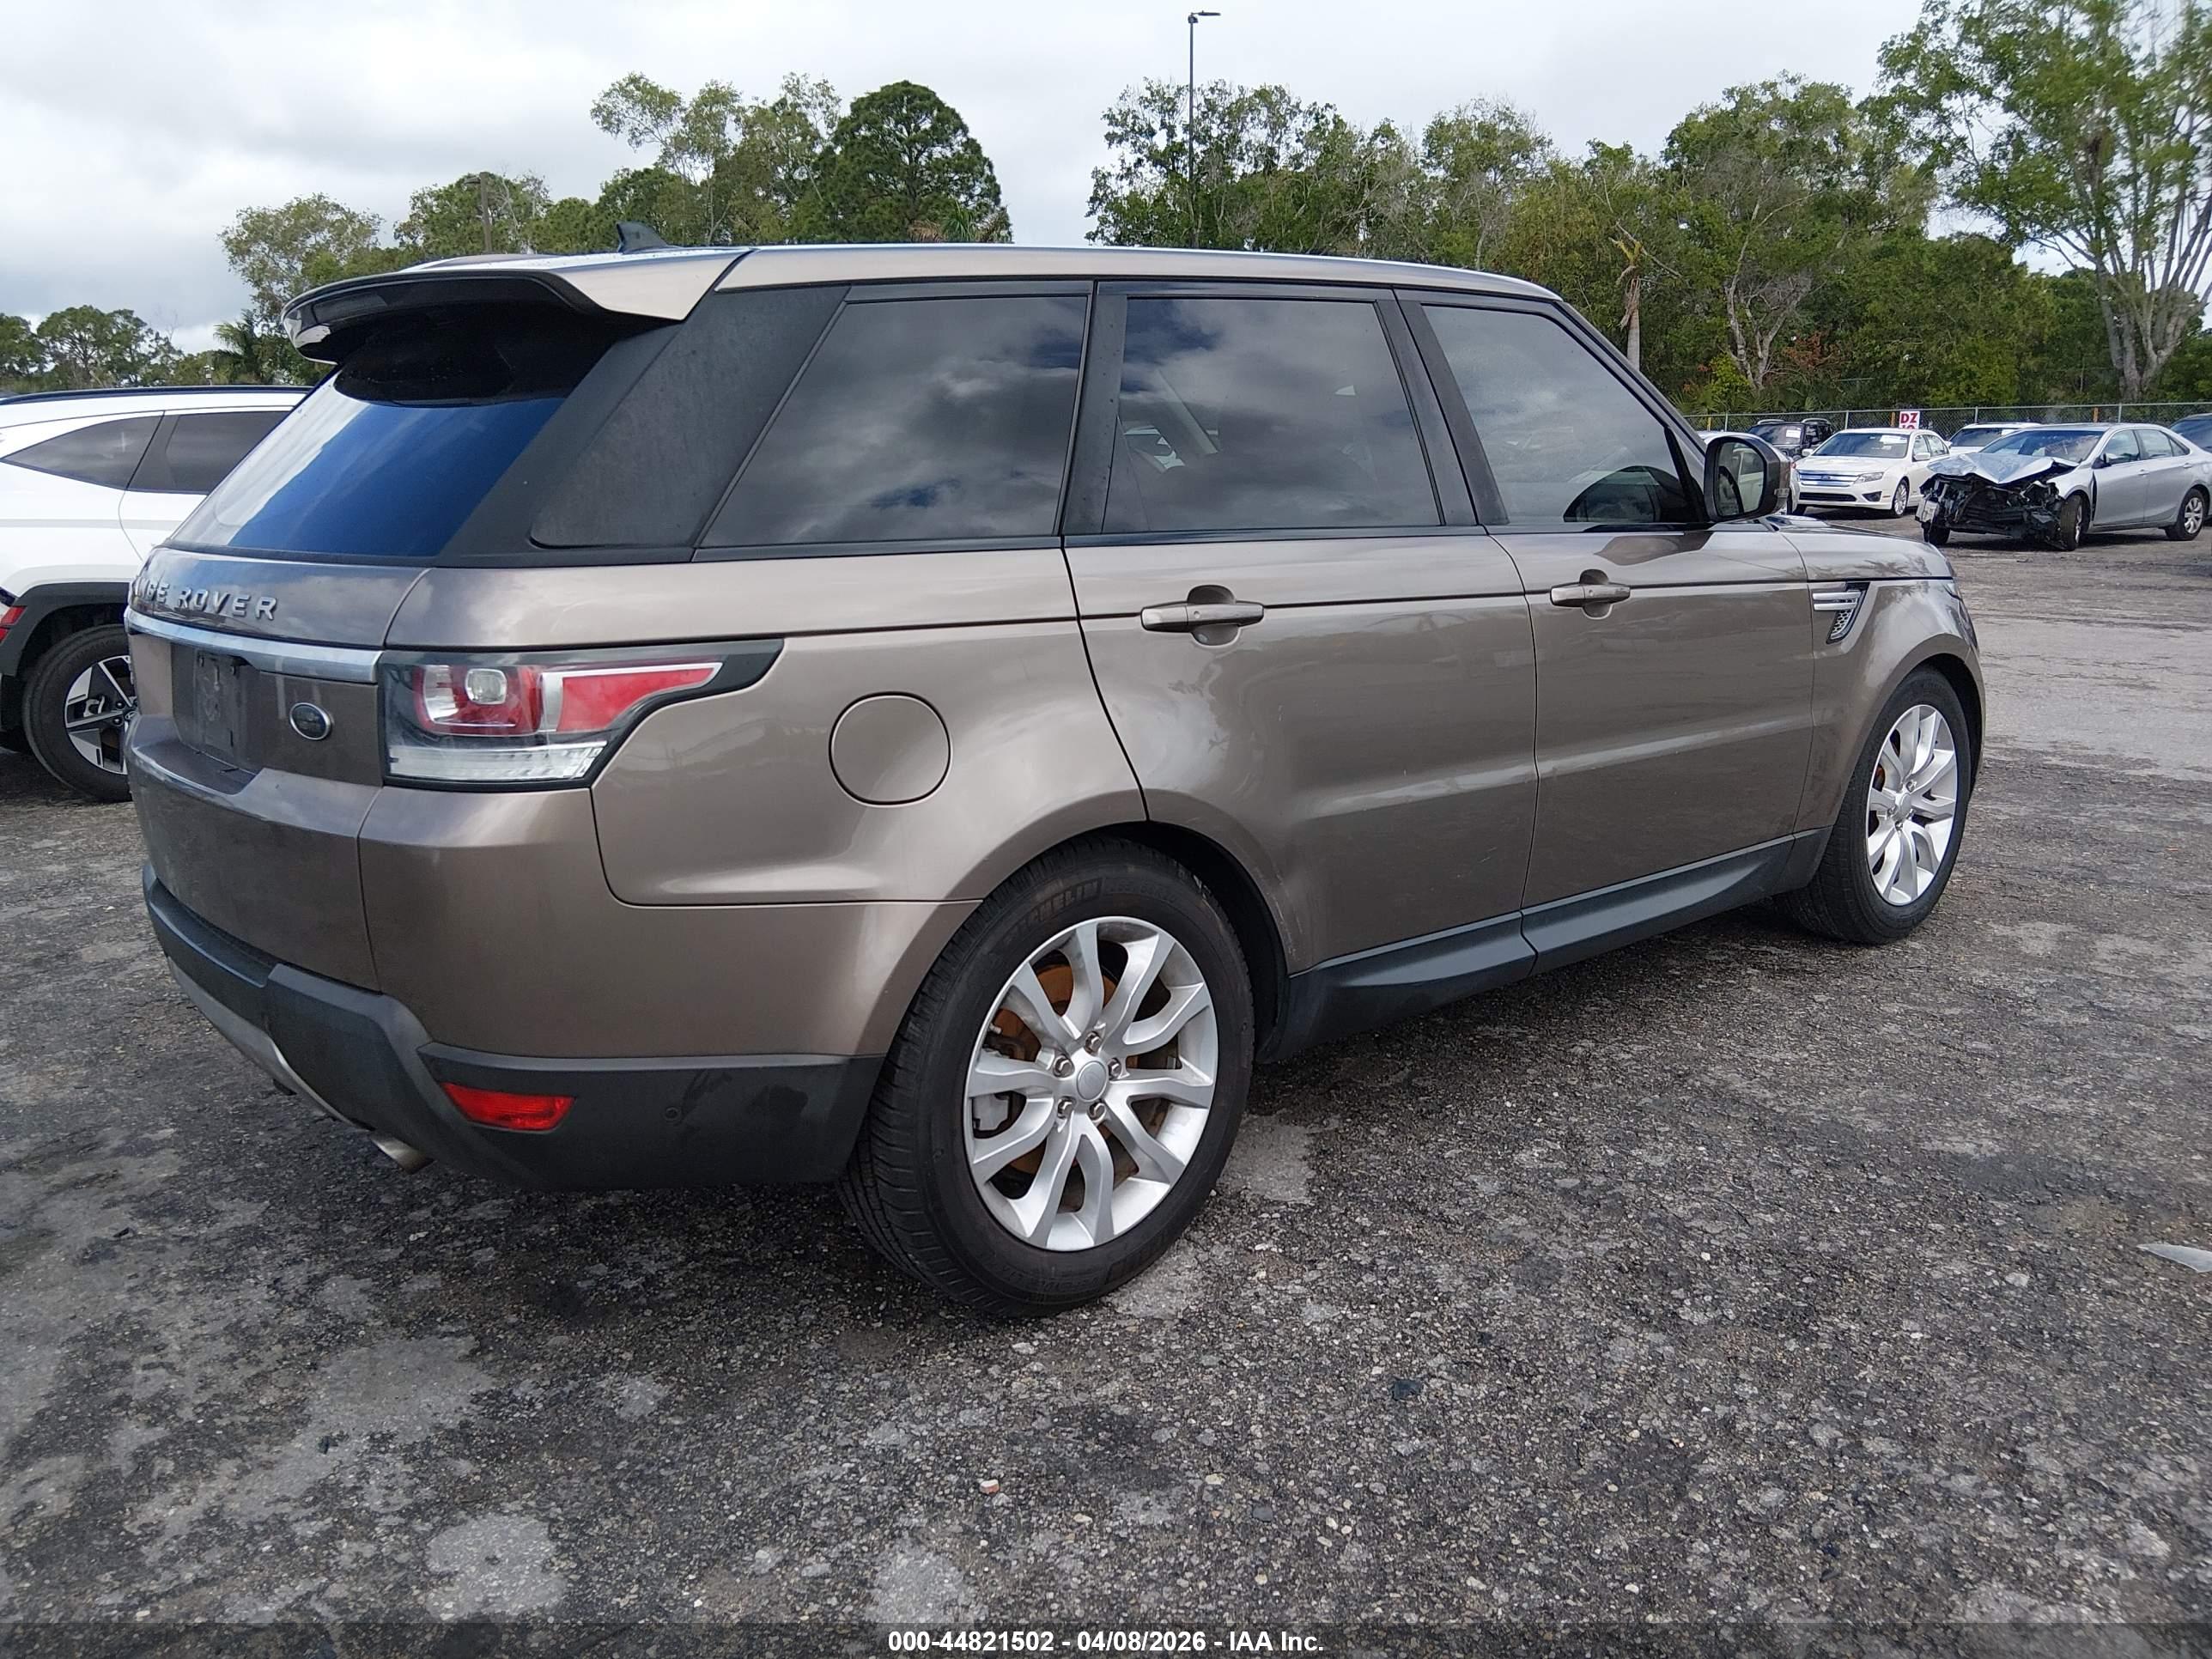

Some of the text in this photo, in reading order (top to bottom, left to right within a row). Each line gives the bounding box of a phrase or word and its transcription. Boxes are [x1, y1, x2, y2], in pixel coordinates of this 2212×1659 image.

[1900, 413, 1918, 423] DZ
[134, 577, 277, 621] NGE ROVER
